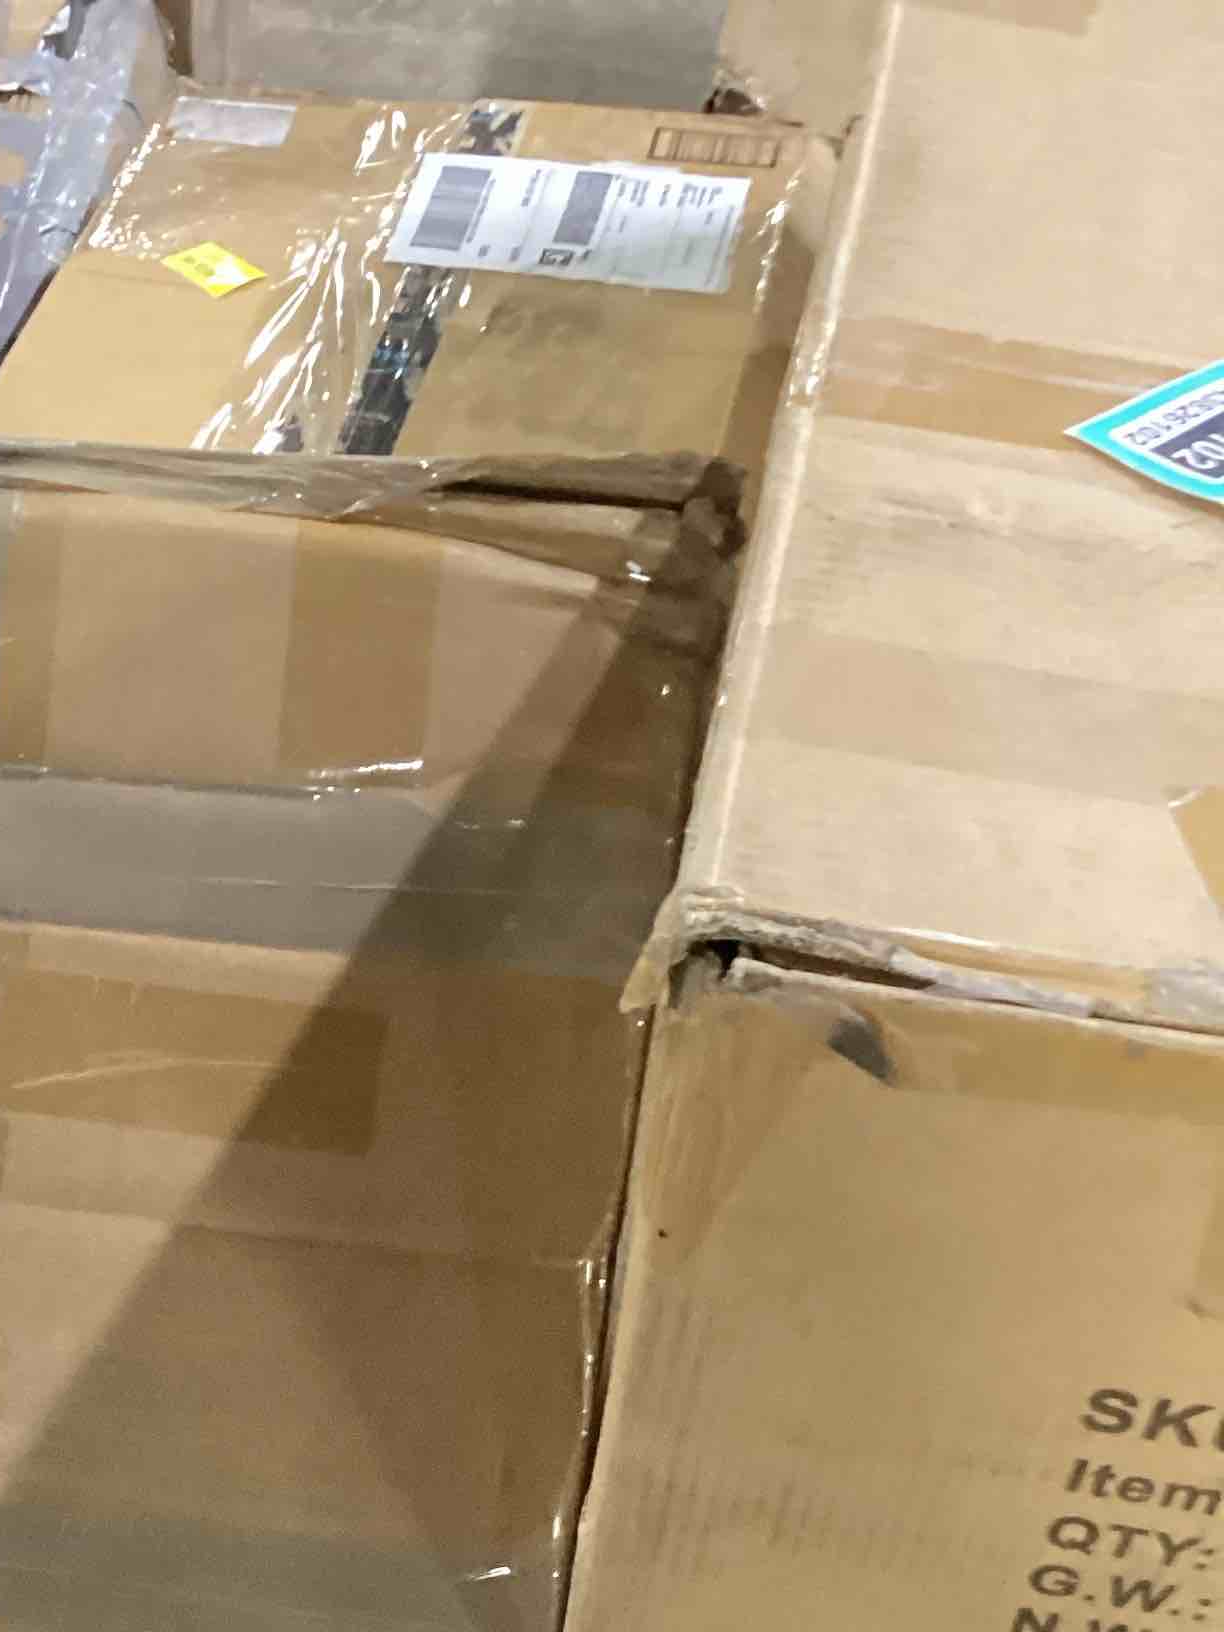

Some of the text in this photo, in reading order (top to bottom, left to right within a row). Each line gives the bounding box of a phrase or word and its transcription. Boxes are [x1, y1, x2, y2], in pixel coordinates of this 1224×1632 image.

[1080, 1388, 1224, 1452] SK
[1066, 1457, 1222, 1516] Item
[1047, 1515, 1216, 1568] QTY:
[1029, 1564, 1213, 1622] G.W.:
